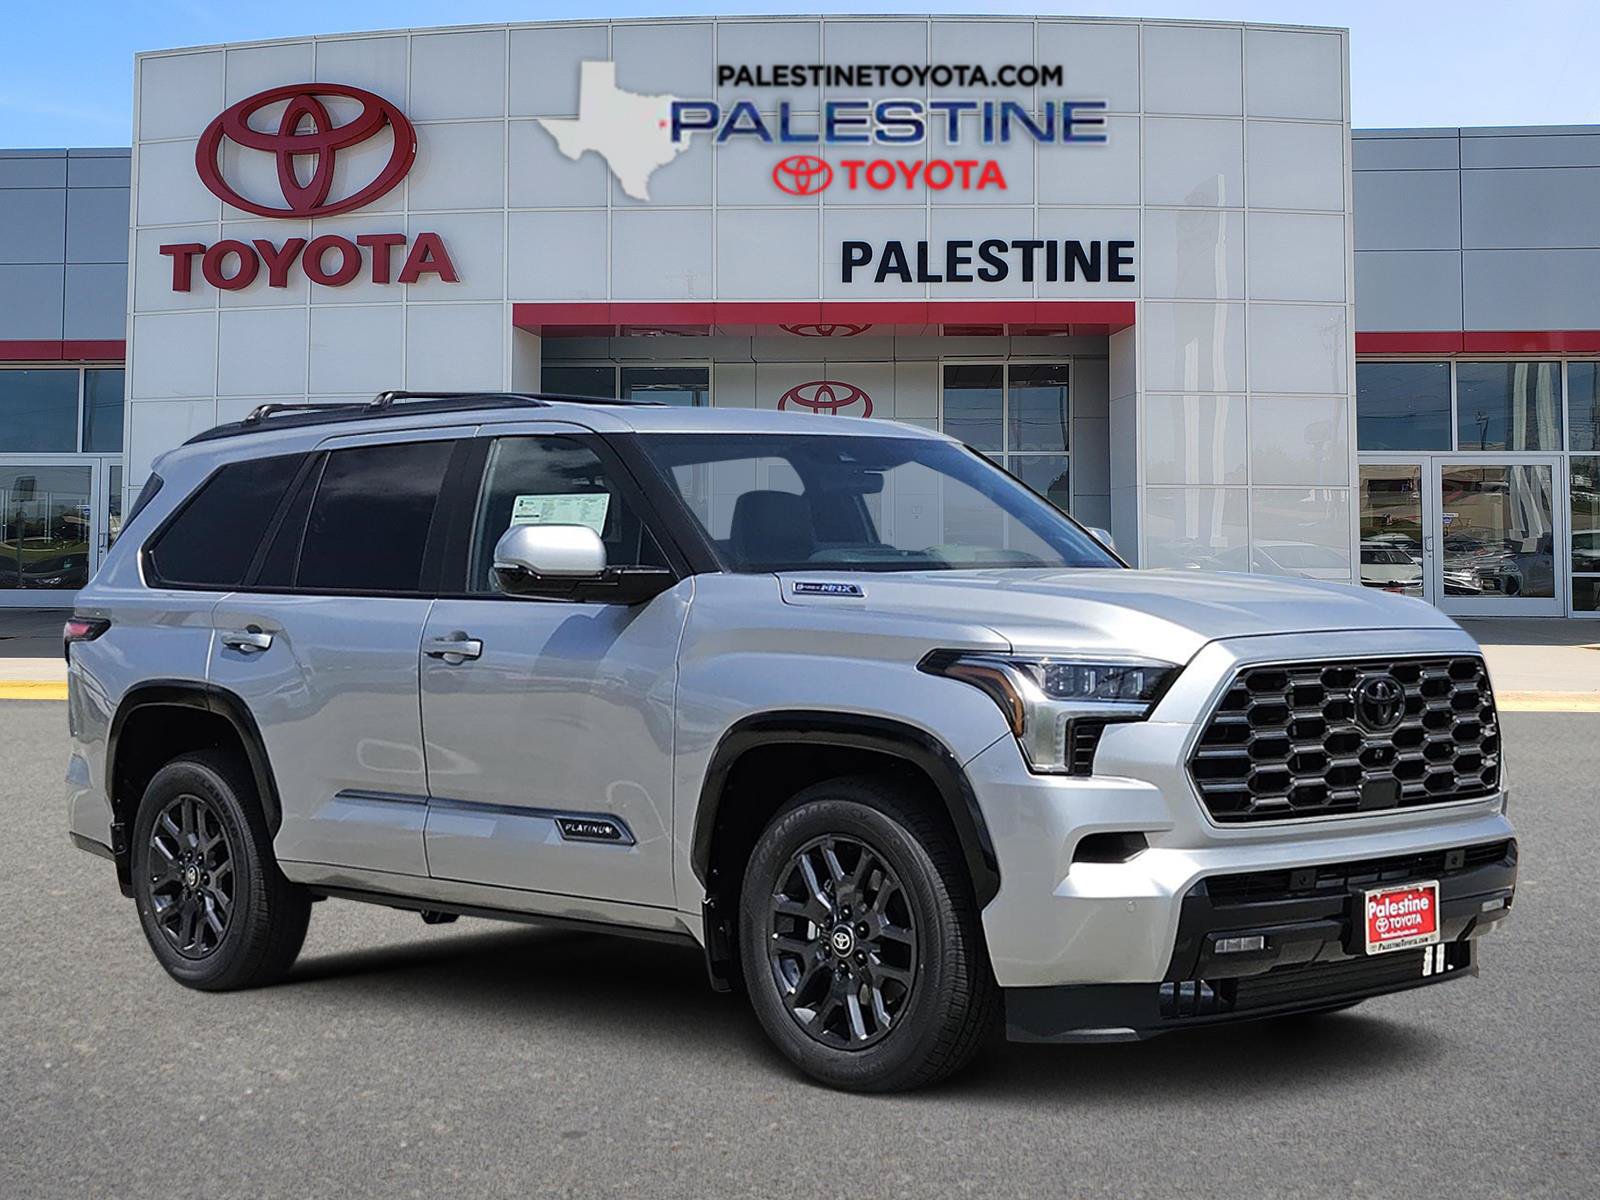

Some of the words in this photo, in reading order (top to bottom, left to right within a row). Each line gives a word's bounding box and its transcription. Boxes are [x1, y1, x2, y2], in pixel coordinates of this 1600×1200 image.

[159, 232, 461, 292] TOYOTA
[842, 240, 1135, 283] PALESTINE
[565, 823, 613, 835] PLATINUM
[1368, 894, 1429, 919] Palestine
[1389, 913, 1422, 929] TOYOTA
